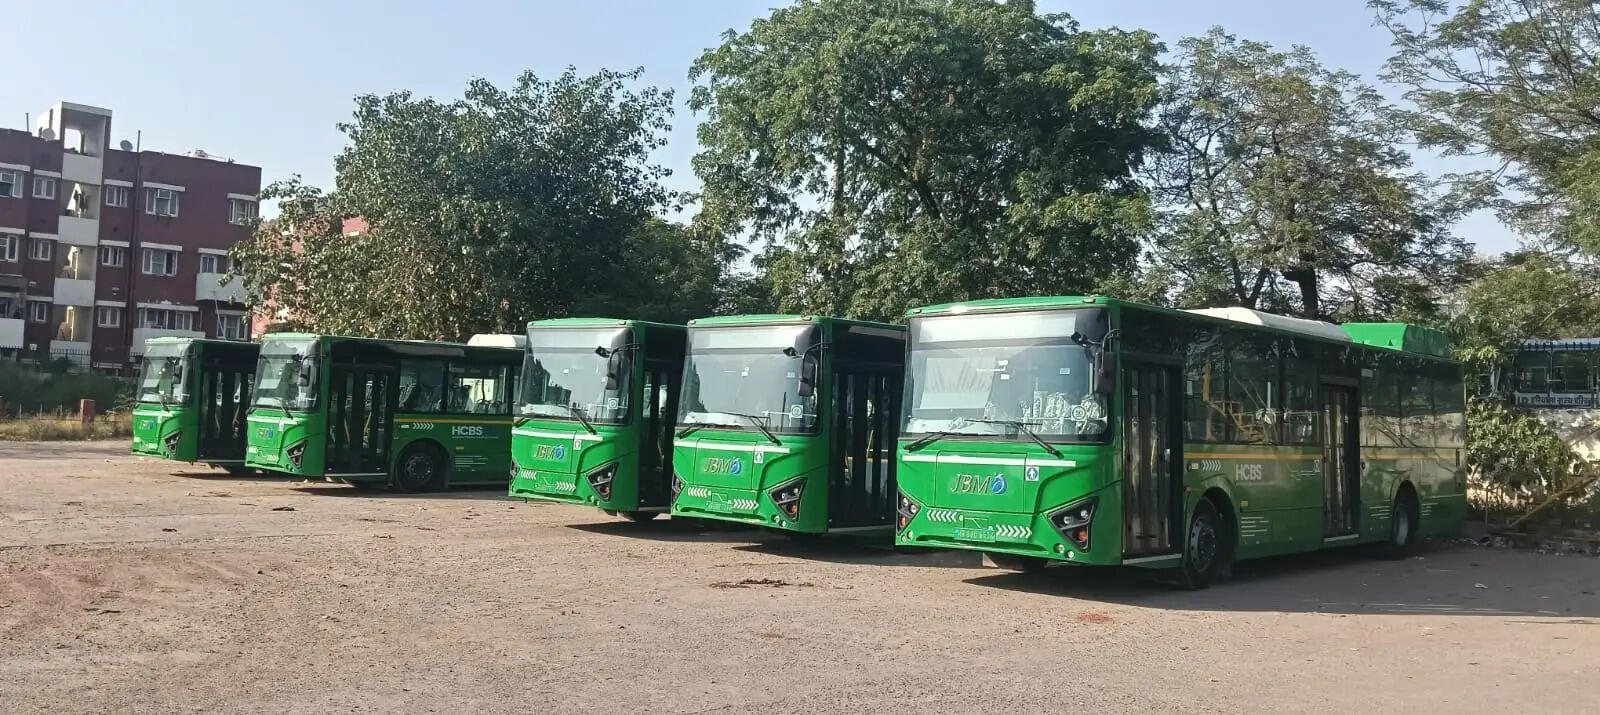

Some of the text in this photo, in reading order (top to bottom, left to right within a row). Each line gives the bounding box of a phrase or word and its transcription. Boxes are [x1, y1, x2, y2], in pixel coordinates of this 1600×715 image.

[452, 425, 483, 436] HCBS
[703, 457, 730, 474] JBM
[1235, 463, 1263, 481] HCBS
[950, 473, 992, 494] JBM
